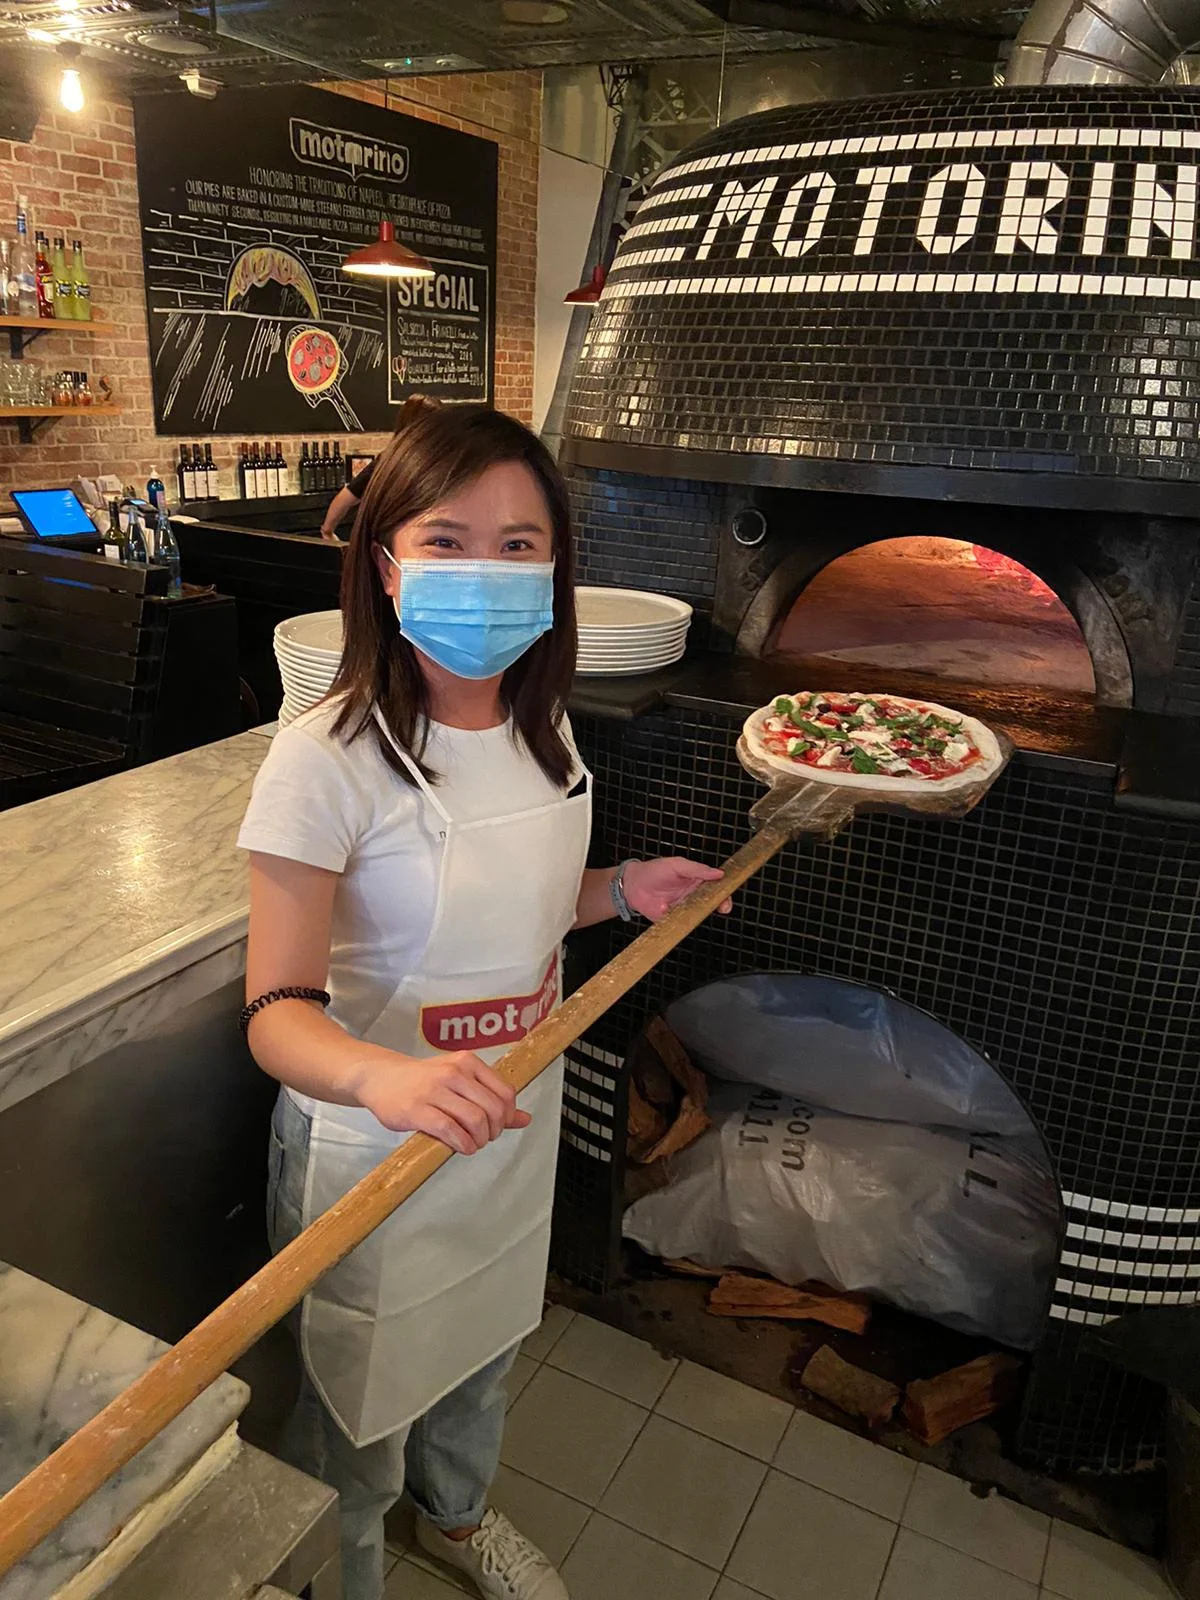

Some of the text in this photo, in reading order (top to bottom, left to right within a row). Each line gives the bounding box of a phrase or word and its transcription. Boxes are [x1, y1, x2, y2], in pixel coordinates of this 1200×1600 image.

[185, 179, 203, 196] OUR
[203, 181, 220, 198] PIES
[221, 185, 236, 200] ARE
[237, 187, 258, 204] BAKED
[259, 191, 267, 205] IN
[268, 192, 273, 207] A
[249, 166, 293, 189] HONORING
[294, 175, 307, 193] THE
[347, 185, 358, 201] OF
[695, 161, 1198, 260] MOTORIN
[397, 274, 479, 312] SPECIAL
